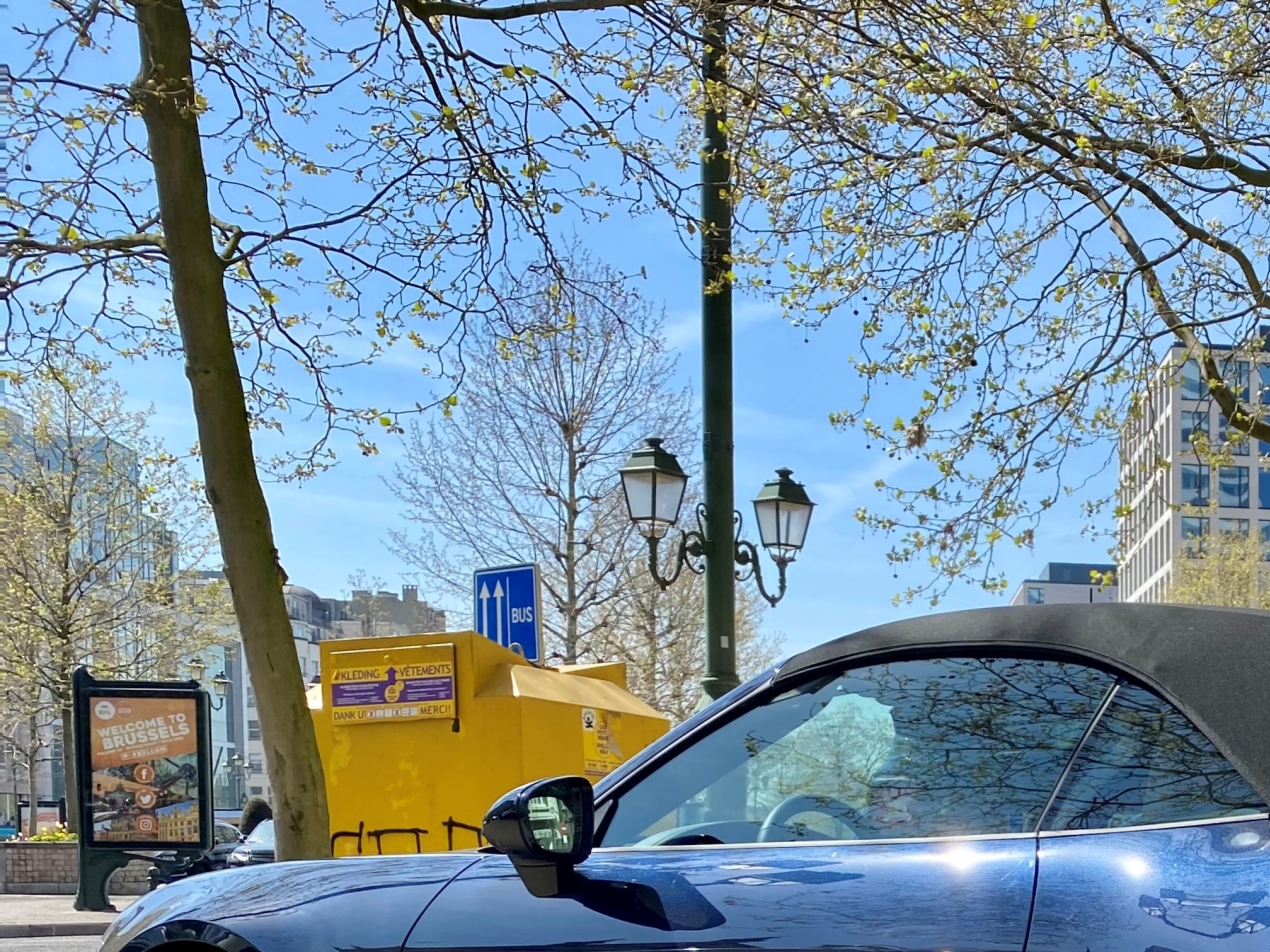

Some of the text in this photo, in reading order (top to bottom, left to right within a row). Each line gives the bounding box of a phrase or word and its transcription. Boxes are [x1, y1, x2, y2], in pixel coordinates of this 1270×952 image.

[511, 606, 533, 624] BUS
[341, 664, 451, 681] KLEDING VÊTEMENTS
[333, 711, 356, 721] DANK
[420, 704, 451, 716] MERCI!
[97, 713, 186, 738] WELCOME TO
[102, 722, 190, 750] BRUSSELS
